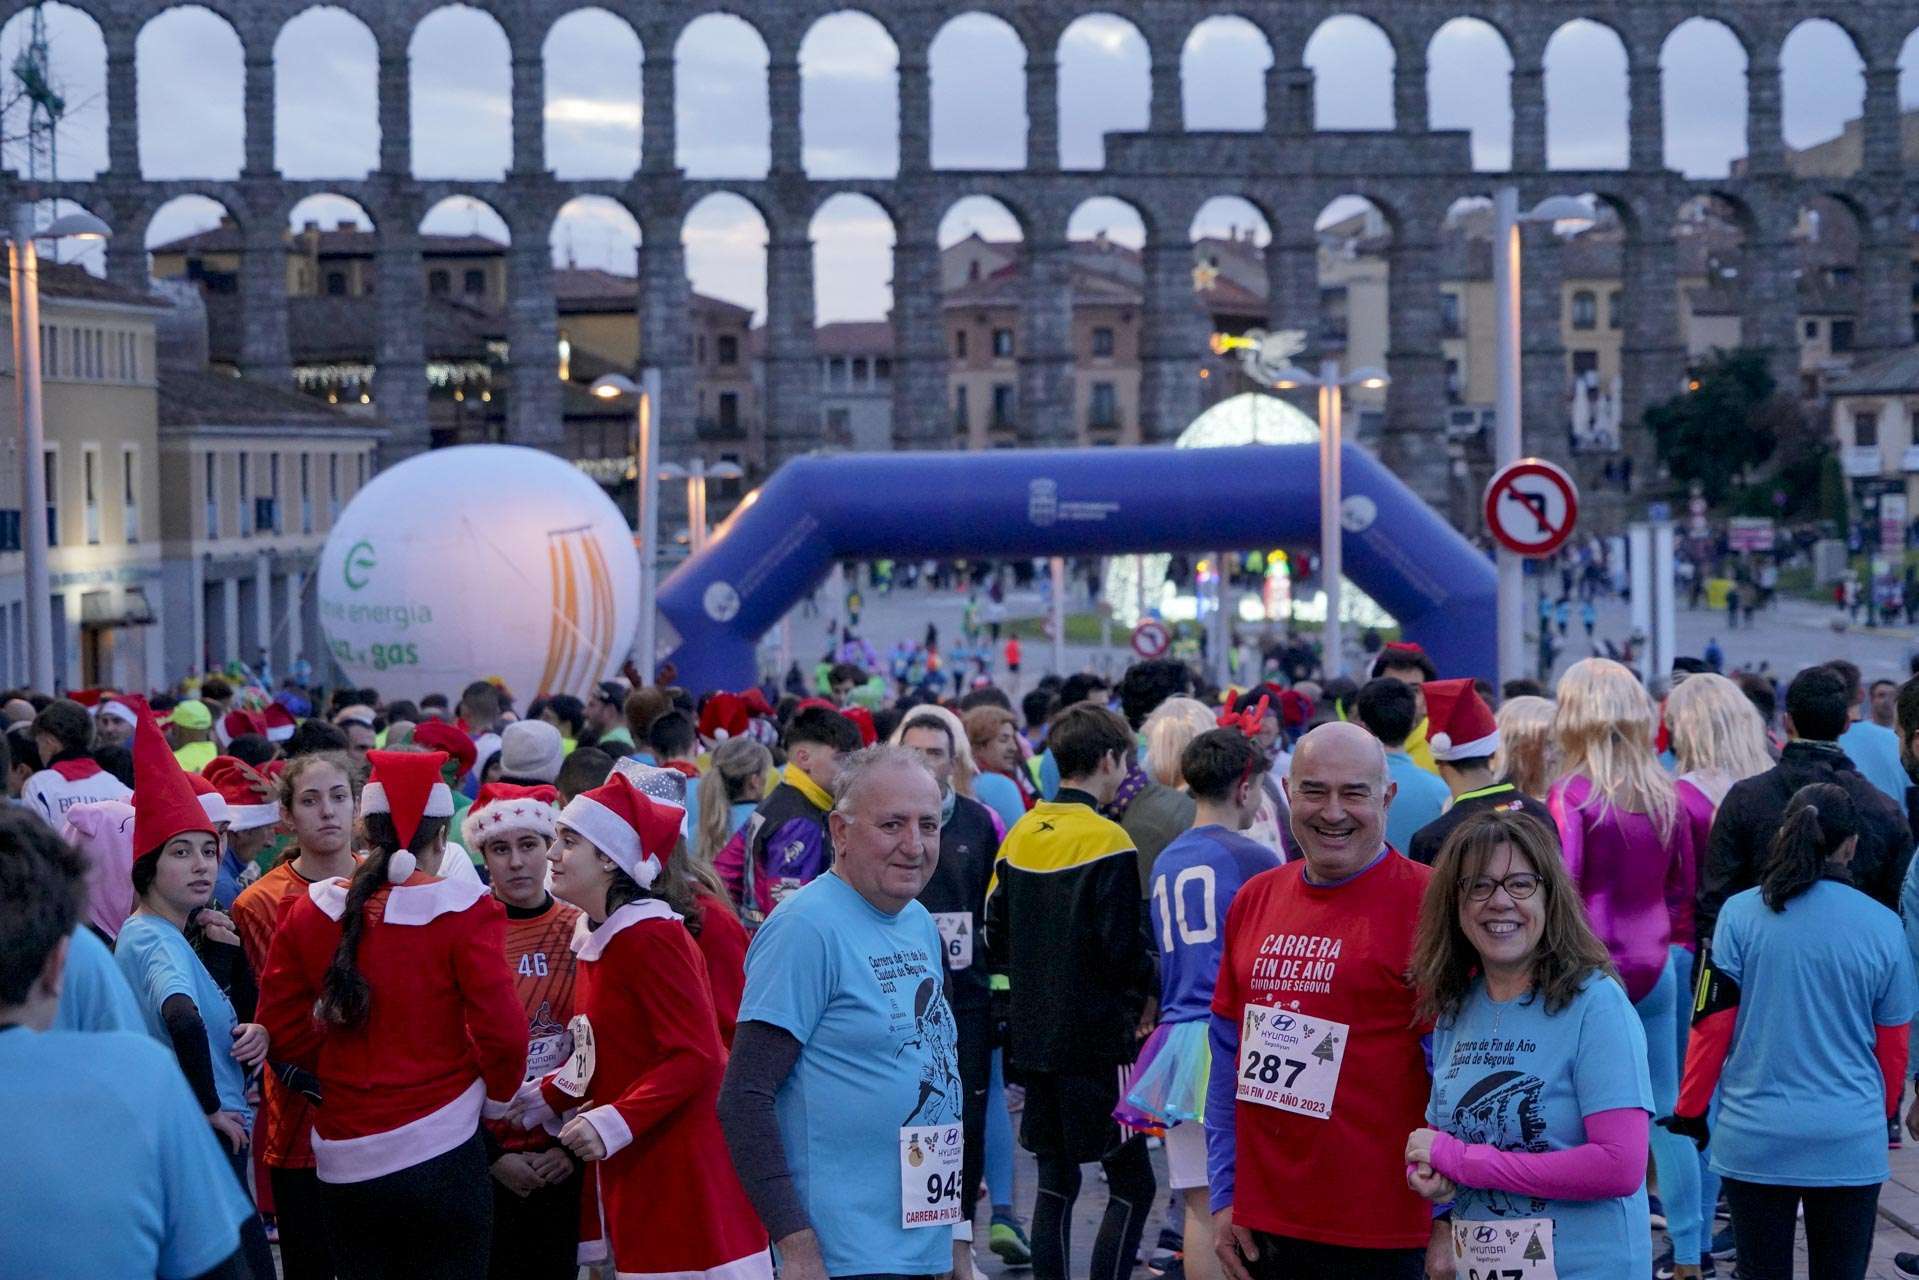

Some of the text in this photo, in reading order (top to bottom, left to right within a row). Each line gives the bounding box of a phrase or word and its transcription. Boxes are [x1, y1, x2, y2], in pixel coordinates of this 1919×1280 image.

[371, 643, 418, 671] gas
[1153, 864, 1217, 953] 10
[1259, 934, 1343, 959] CARRERA
[518, 952, 548, 977] 46
[1252, 957, 1335, 981] FIN DE AÑO
[1250, 978, 1330, 994] CIUDAD DE SEGOVIA
[1261, 1030, 1299, 1045] HYUNDAI
[1479, 1039, 1489, 1051] de
[1490, 1038, 1503, 1051] Fin
[1504, 1040, 1515, 1051] de
[1516, 1039, 1536, 1053] Año
[1244, 1050, 1307, 1089] 287
[1472, 1053, 1482, 1065] de
[1483, 1052, 1515, 1068] Segovia
[1250, 1086, 1264, 1099] FIN
[1265, 1090, 1279, 1102] DE
[1280, 1092, 1298, 1110] AÑO
[1300, 1099, 1325, 1113] 2023
[906, 1209, 938, 1223] CARRERA
[940, 1208, 950, 1220] FIN
[950, 1207, 959, 1219] DE
[1470, 1245, 1506, 1254] HYUNDAI
